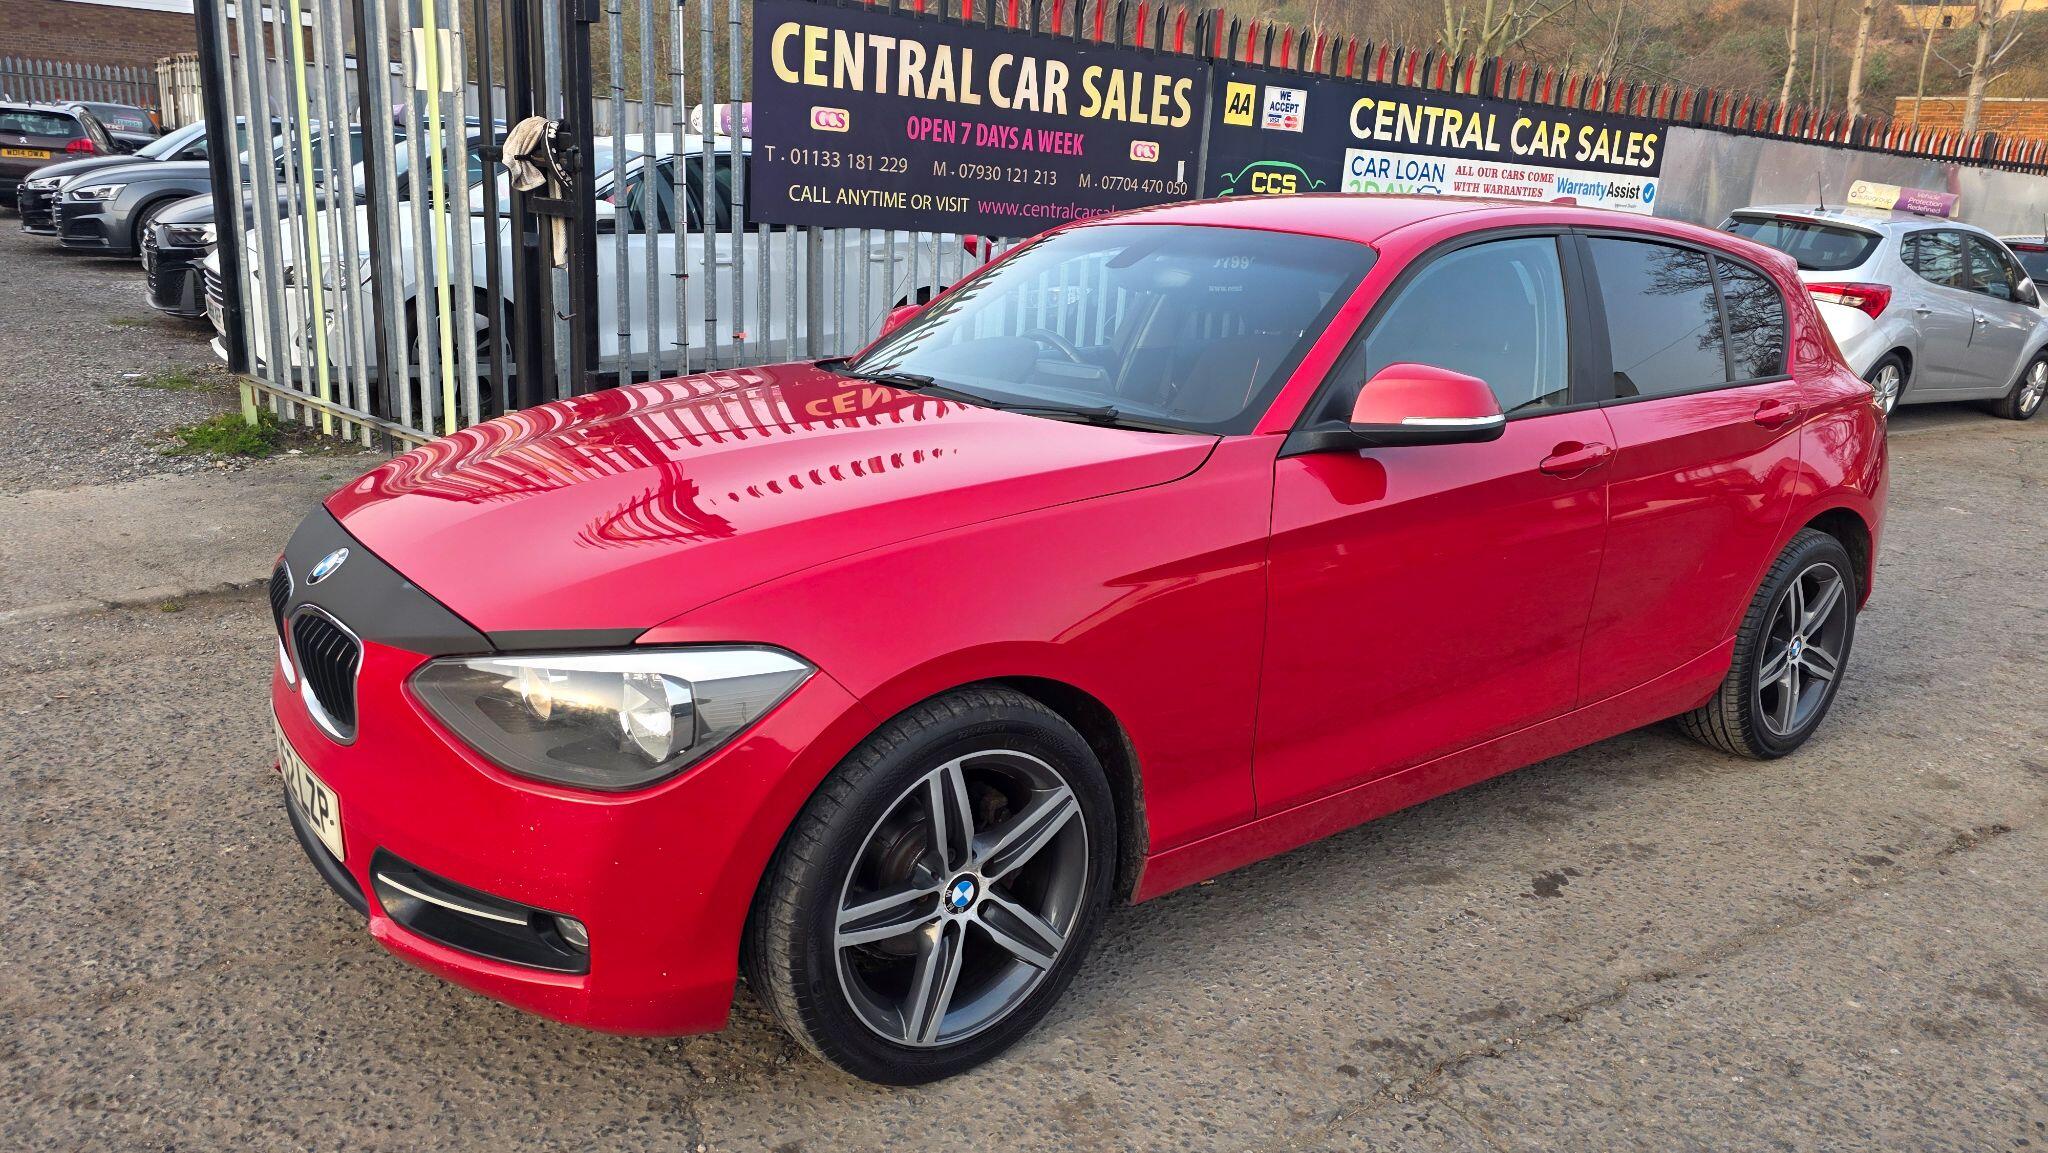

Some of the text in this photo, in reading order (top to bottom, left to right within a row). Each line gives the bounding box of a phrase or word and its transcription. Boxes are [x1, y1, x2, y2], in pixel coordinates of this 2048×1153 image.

[771, 21, 1193, 128] CENTRAL CAR SALES
[1228, 92, 1251, 116] AA
[1280, 90, 1292, 101] WE
[1269, 101, 1299, 114] ACCEPT
[906, 115, 1085, 156] OPEN 7 DAYS A WEEK
[1350, 97, 1658, 168] CENTRAL CAR SALES
[790, 148, 841, 168] 01133
[847, 153, 873, 170] 181
[878, 156, 908, 173] 229
[1351, 155, 1446, 183] CAR LOAN
[959, 163, 1001, 181] 07930
[1006, 167, 1028, 183] 121
[1033, 169, 1057, 186] 213
[1101, 175, 1139, 192] 07704
[1141, 179, 1163, 194] 470
[1166, 181, 1188, 196] 050
[1251, 171, 1297, 194] CCS
[1455, 165, 1555, 184] ALL OUR CARS COME
[788, 184, 831, 204] CALL
[836, 187, 907, 209] ANYTIME
[910, 194, 932, 211] OR
[935, 195, 971, 213] VISIT
[1453, 181, 1544, 198] WITH WARRANTIES
[1907, 197, 1943, 208] Protection
[1907, 203, 1941, 214] Redefined
